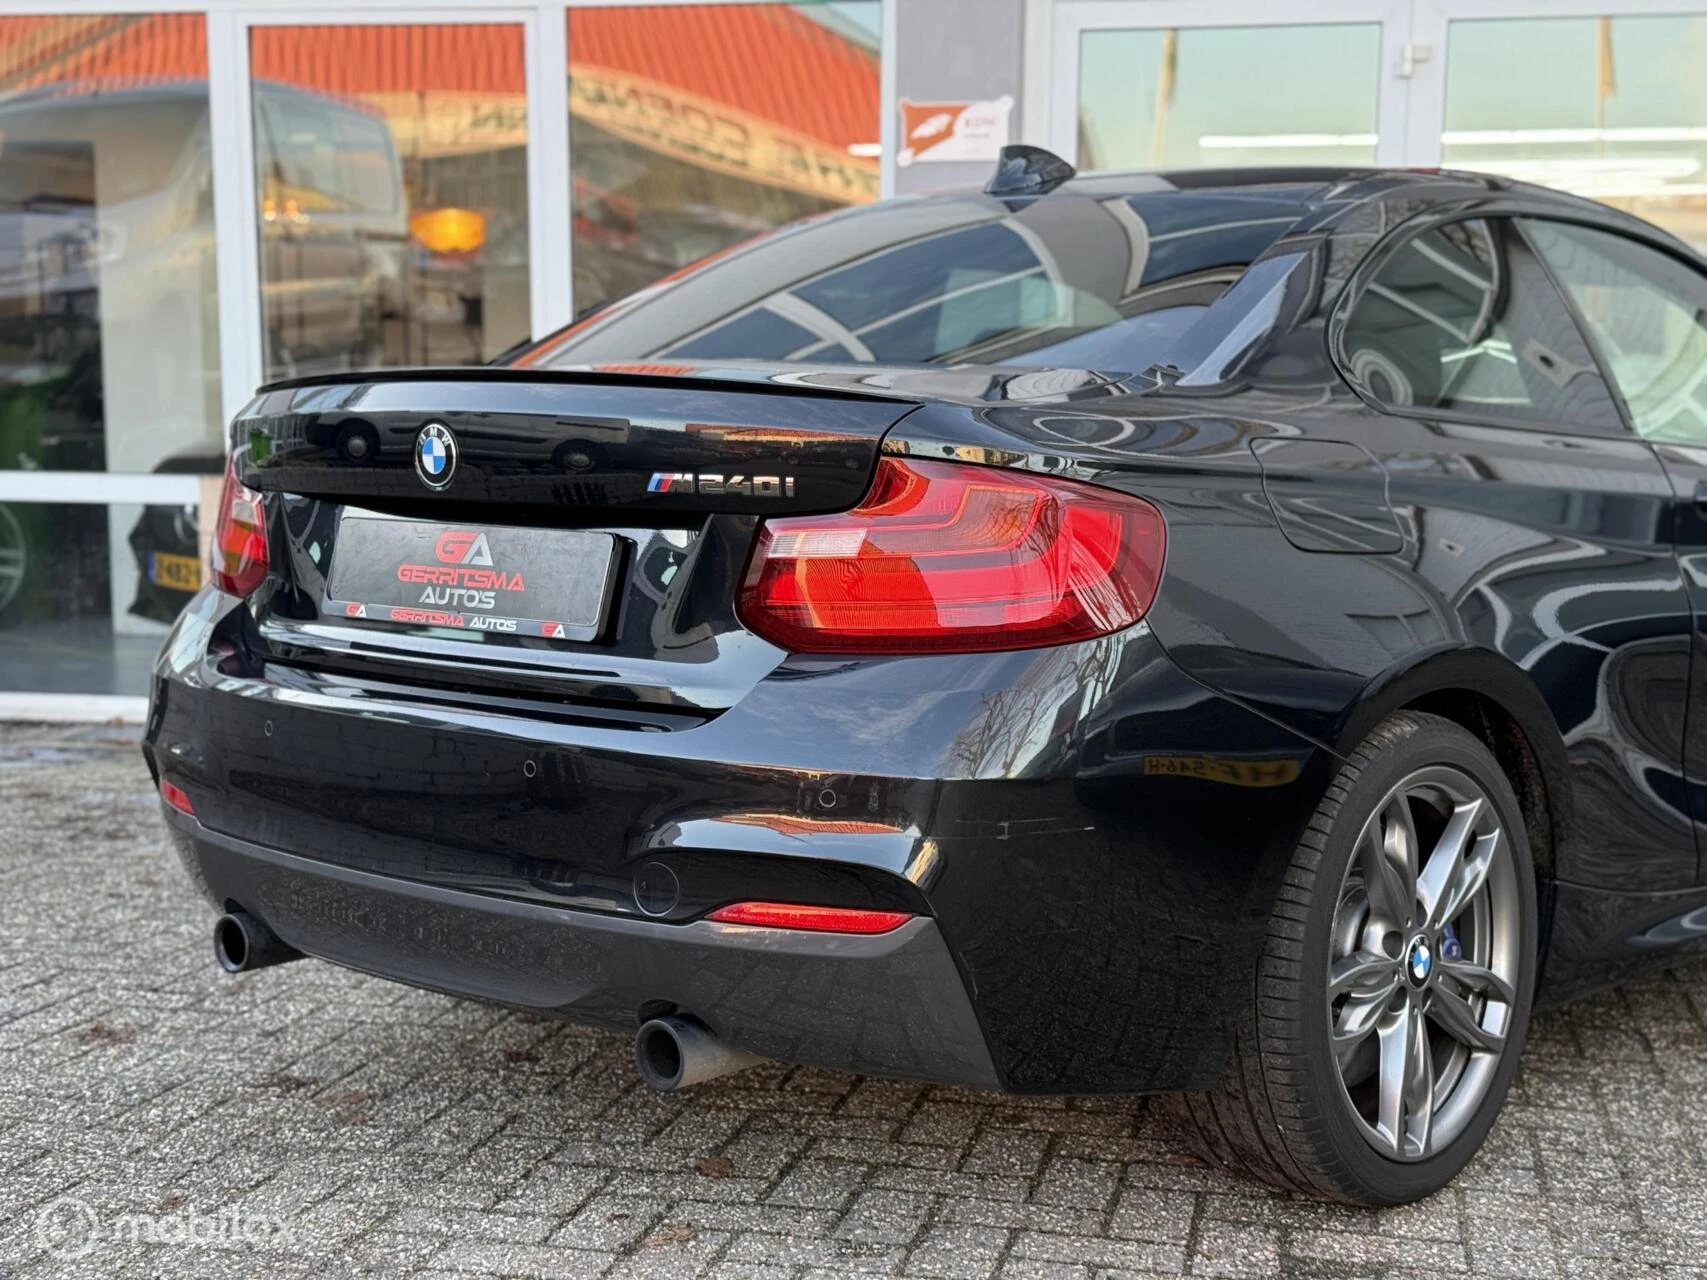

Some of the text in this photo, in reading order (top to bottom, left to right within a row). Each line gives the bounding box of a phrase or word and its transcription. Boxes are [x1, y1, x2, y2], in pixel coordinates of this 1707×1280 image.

[668, 473, 795, 497] M240i
[435, 530, 494, 566] GA
[397, 564, 525, 591] GERRITSMA
[419, 586, 496, 609] AUTO'S
[346, 602, 367, 618] GA
[390, 609, 465, 626] GERRITSMA
[540, 621, 566, 638] GA
